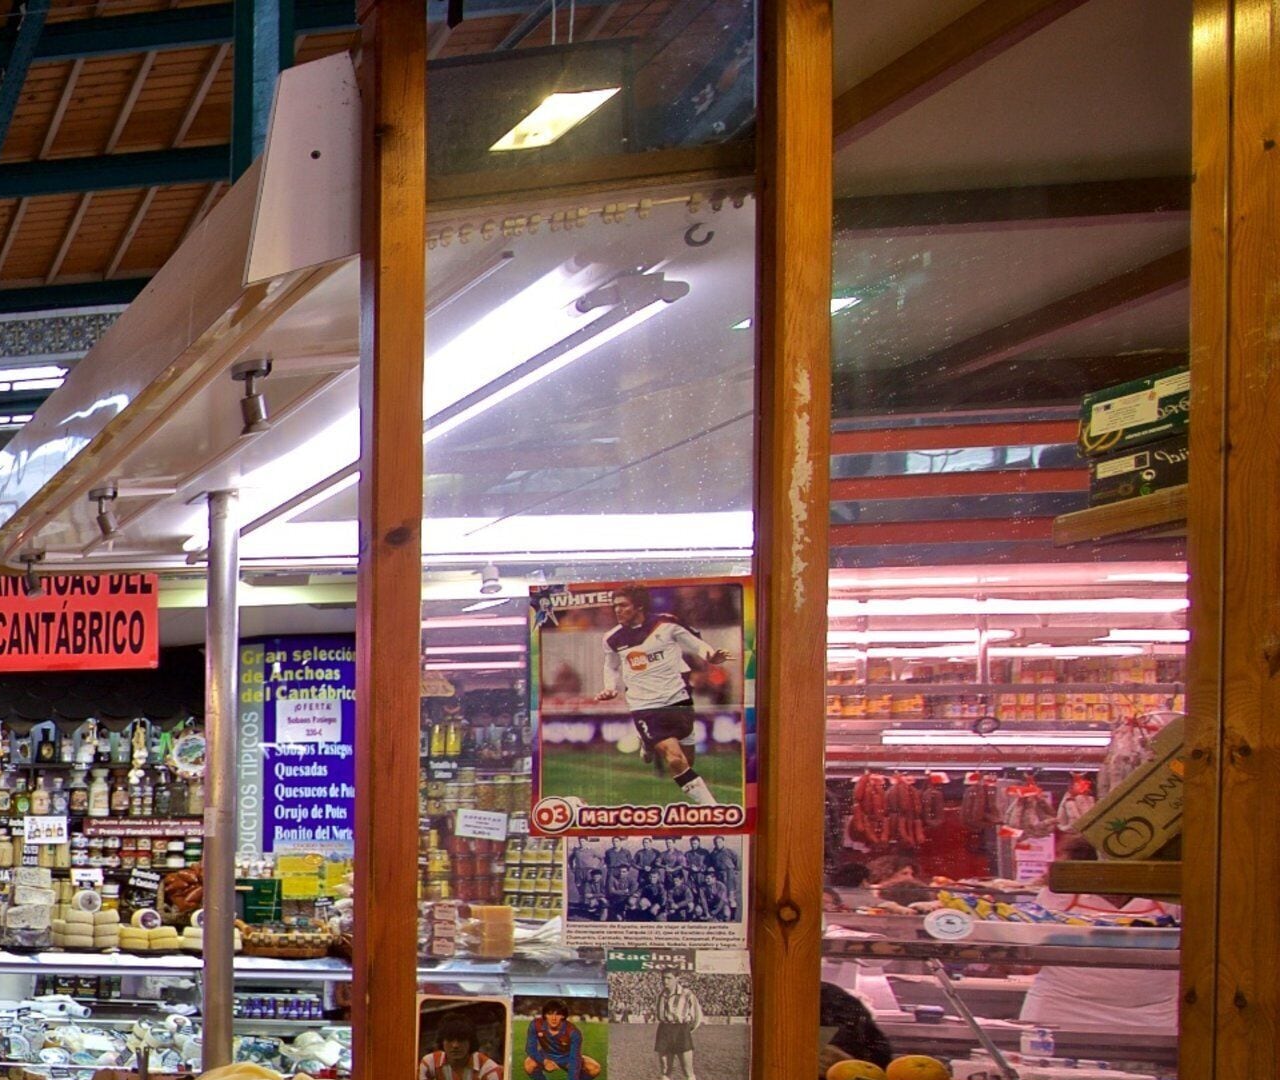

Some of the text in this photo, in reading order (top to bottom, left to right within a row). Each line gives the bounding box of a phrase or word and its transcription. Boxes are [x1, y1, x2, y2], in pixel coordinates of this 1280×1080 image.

[109, 574, 152, 595] DEL
[550, 590, 614, 605] WHITE!
[242, 650, 287, 664] Gran
[242, 667, 340, 683] de Anchoas
[242, 684, 356, 702] del Cantábrico
[287, 716, 337, 725] Sobaos Pasiegos
[238, 711, 258, 779] TÍPICOS
[318, 741, 352, 758] Pasiegos
[274, 762, 328, 778] Quesadas
[274, 783, 341, 800] Quesucos de
[274, 803, 347, 822] Orujo de Potes
[540, 802, 740, 823] 03 Alonso
[98, 828, 125, 836] Premio
[126, 827, 163, 836] Fundación
[274, 825, 353, 840] Bonito del Norte
